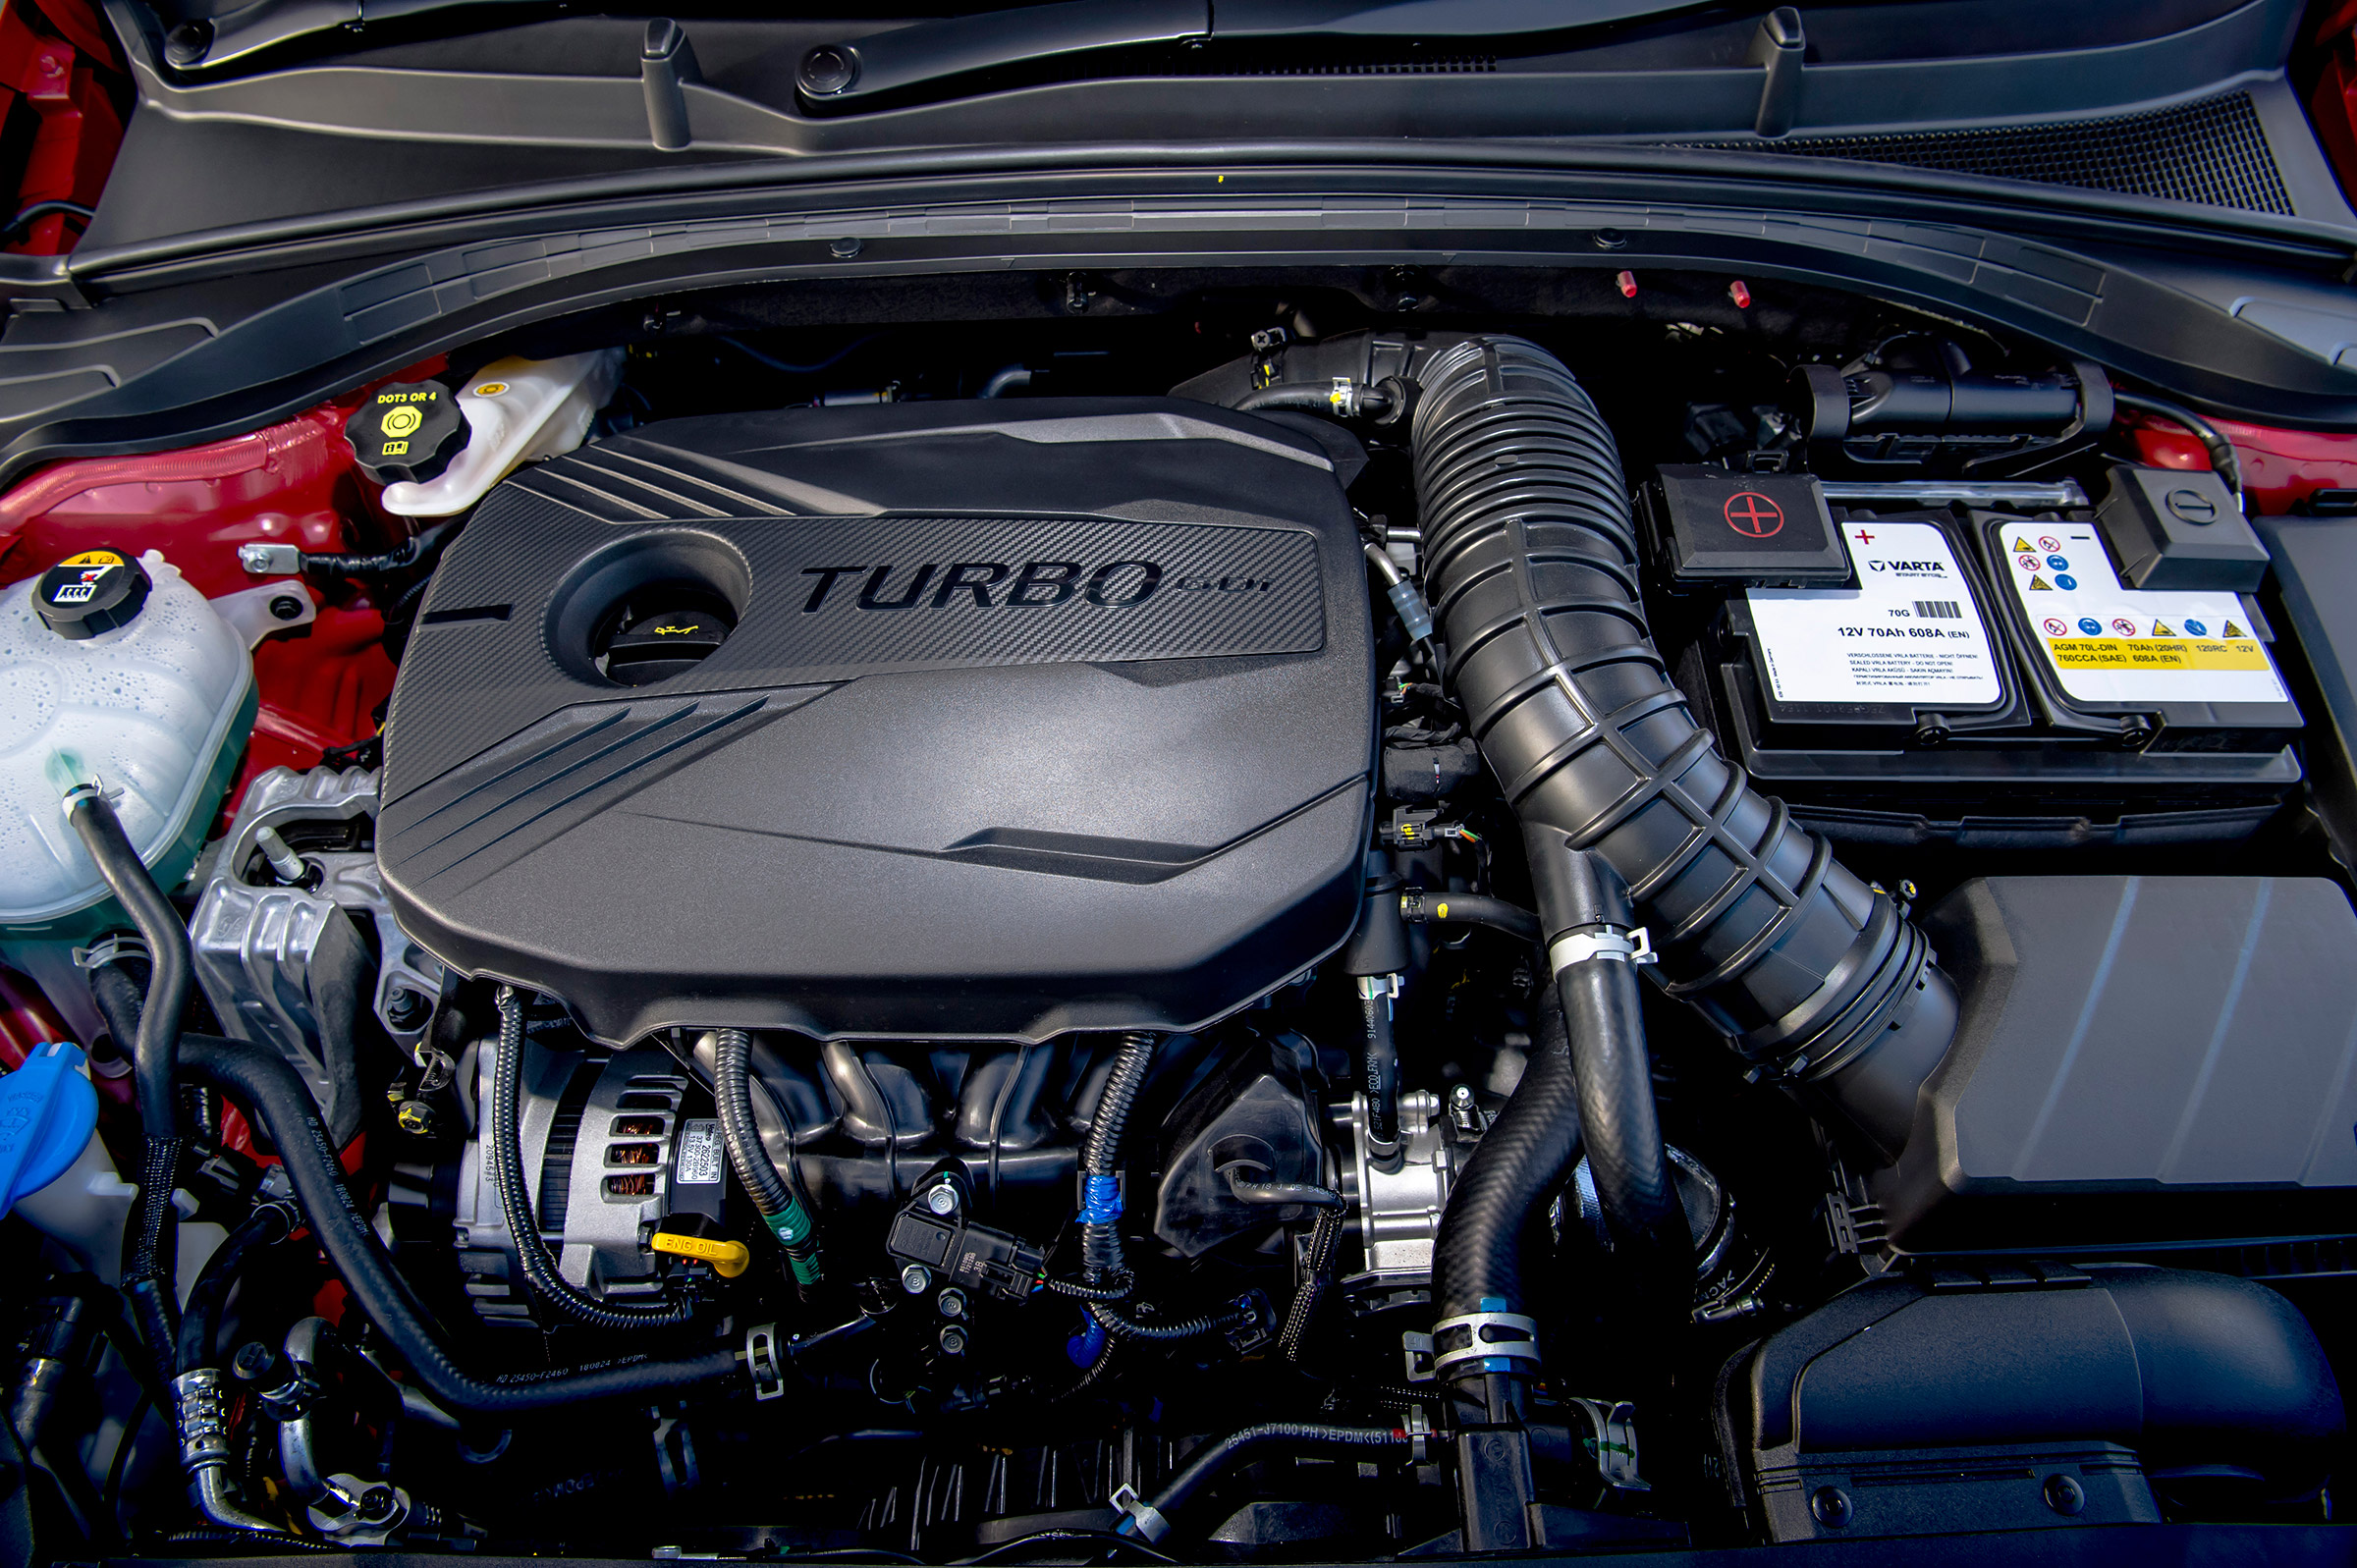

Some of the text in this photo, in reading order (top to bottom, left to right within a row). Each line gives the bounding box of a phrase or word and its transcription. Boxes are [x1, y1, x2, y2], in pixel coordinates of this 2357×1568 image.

[377, 391, 437, 405] DOT3 OR 4
[1888, 561, 1945, 571] VARTA
[799, 561, 1164, 615] TURBO
[1888, 609, 1910, 618] 70G
[1837, 626, 1970, 639] 12V 70Ah 608A (EN)
[2078, 643, 2117, 652] 70L-DIN
[2155, 644, 2188, 653] (20HR)
[2196, 644, 2227, 653] 120RC
[2099, 655, 2127, 664] (SAE)
[2160, 655, 2182, 664] (EN)
[1363, 1000, 1377, 1039] 91440603
[698, 1145, 711, 1176] 2622503
[665, 1237, 717, 1256] ENG OIL
[510, 1368, 569, 1383] 25450-F2460
[579, 1359, 611, 1372] 180824
[1225, 1422, 1298, 1450] 25451-J7100
[1301, 1427, 1319, 1438] PH
